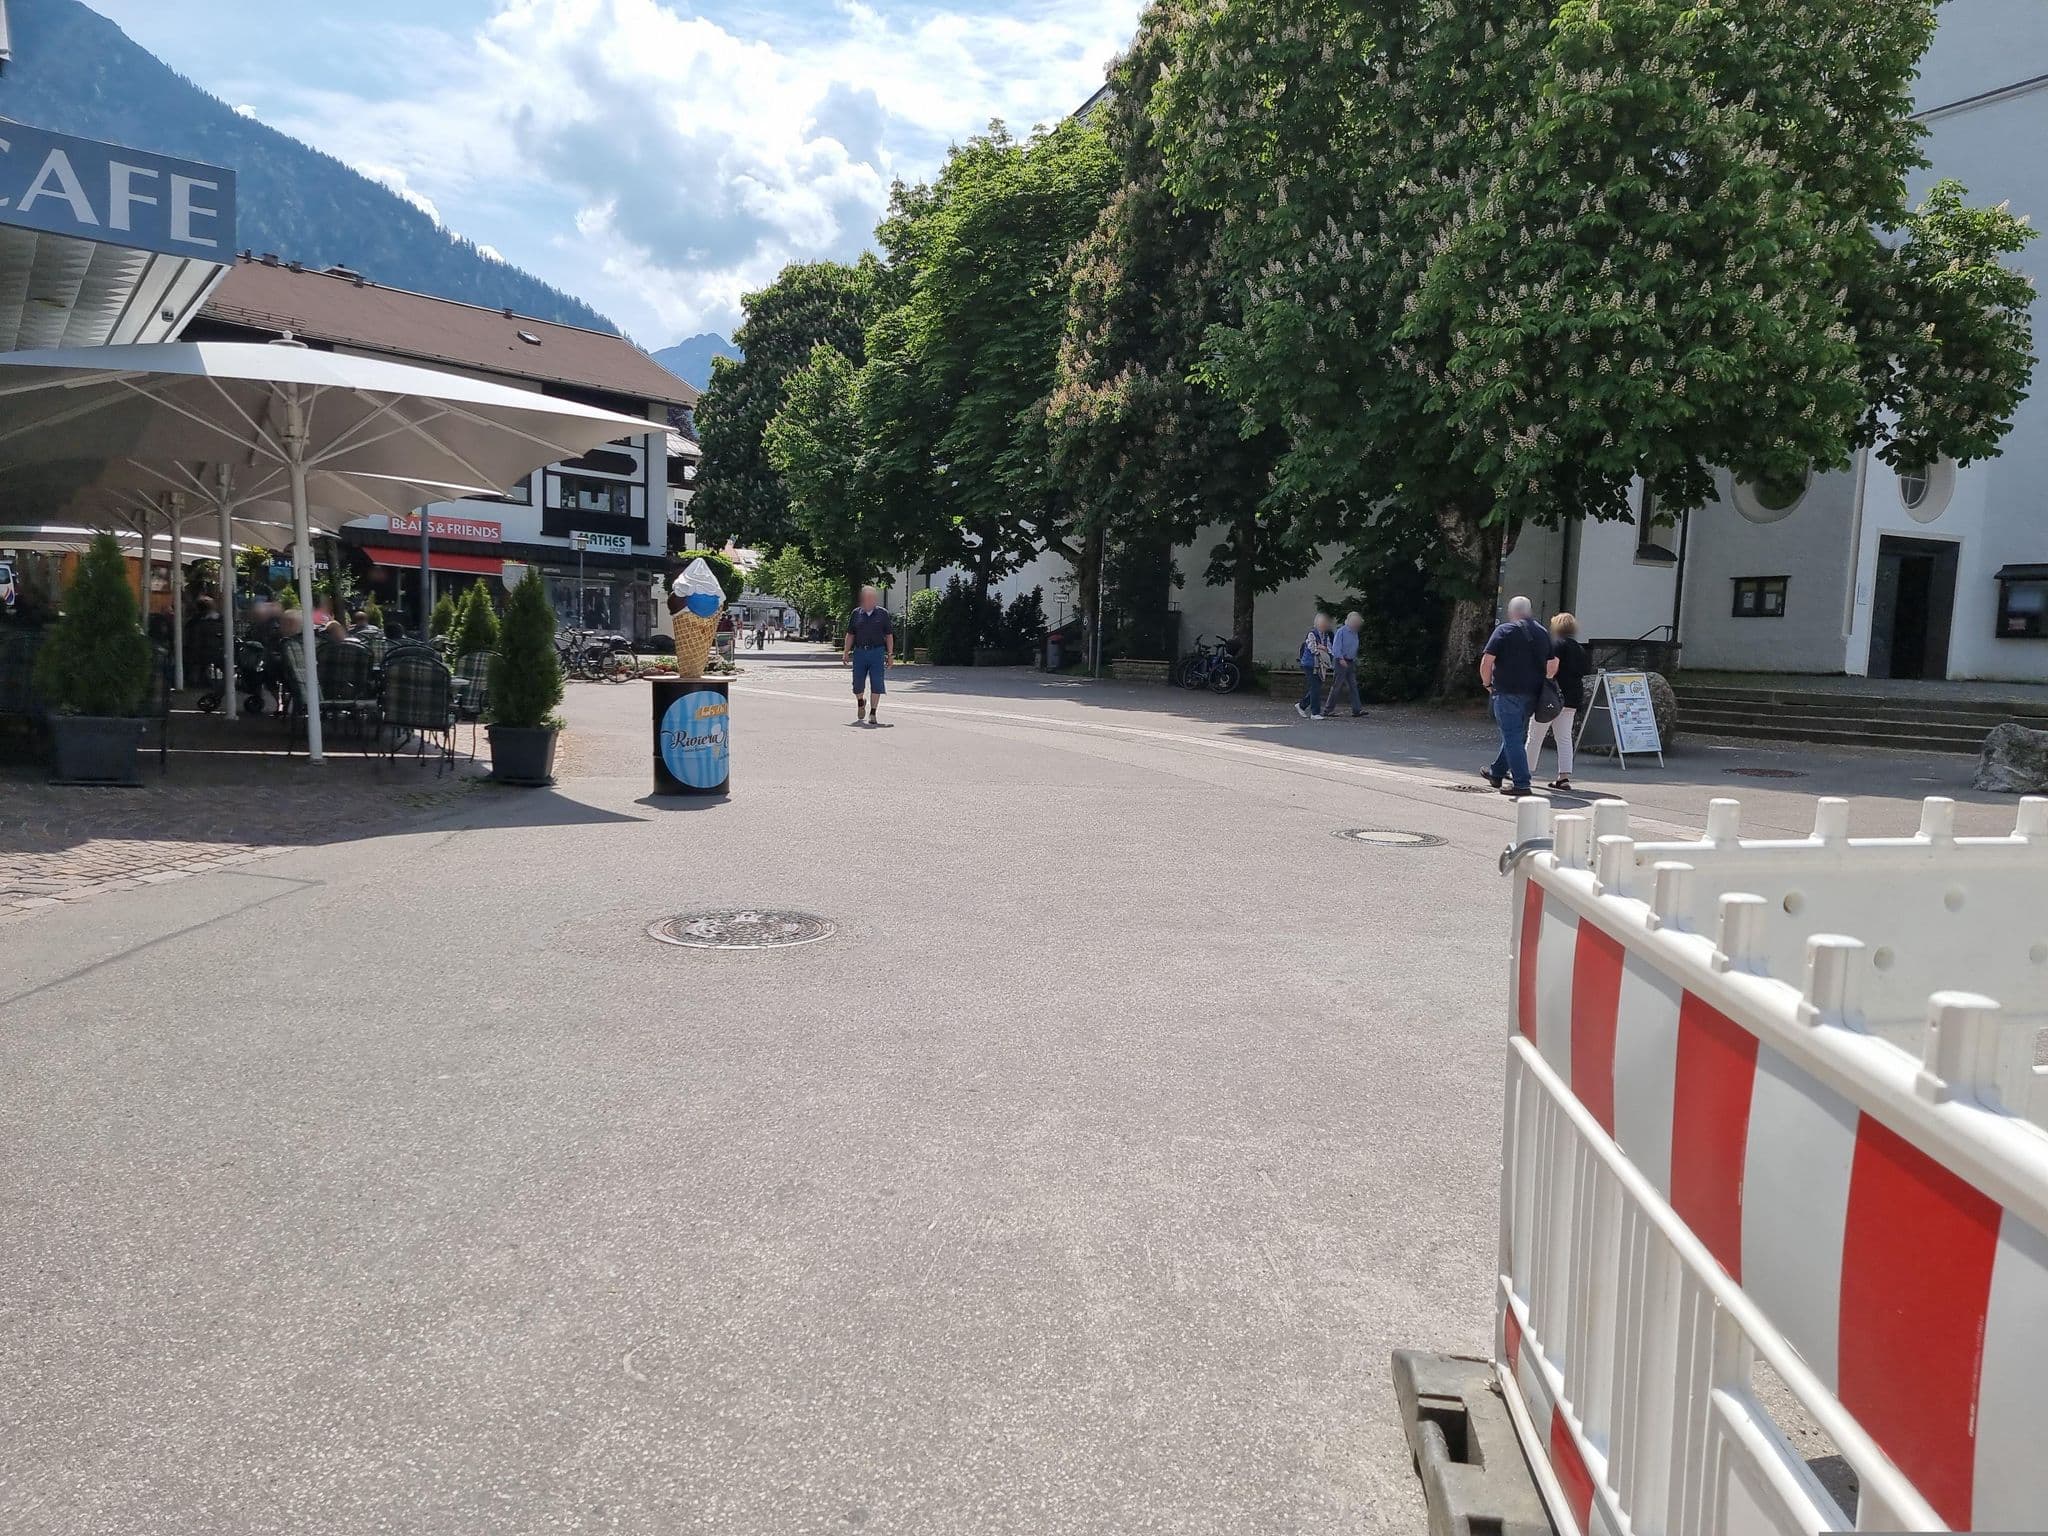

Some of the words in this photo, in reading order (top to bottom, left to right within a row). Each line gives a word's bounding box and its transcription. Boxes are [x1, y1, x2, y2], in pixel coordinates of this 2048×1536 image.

[0, 137, 218, 248] AFE
[436, 522, 445, 533] &
[447, 523, 499, 539] FRIENDS
[668, 729, 724, 749] Riviera
